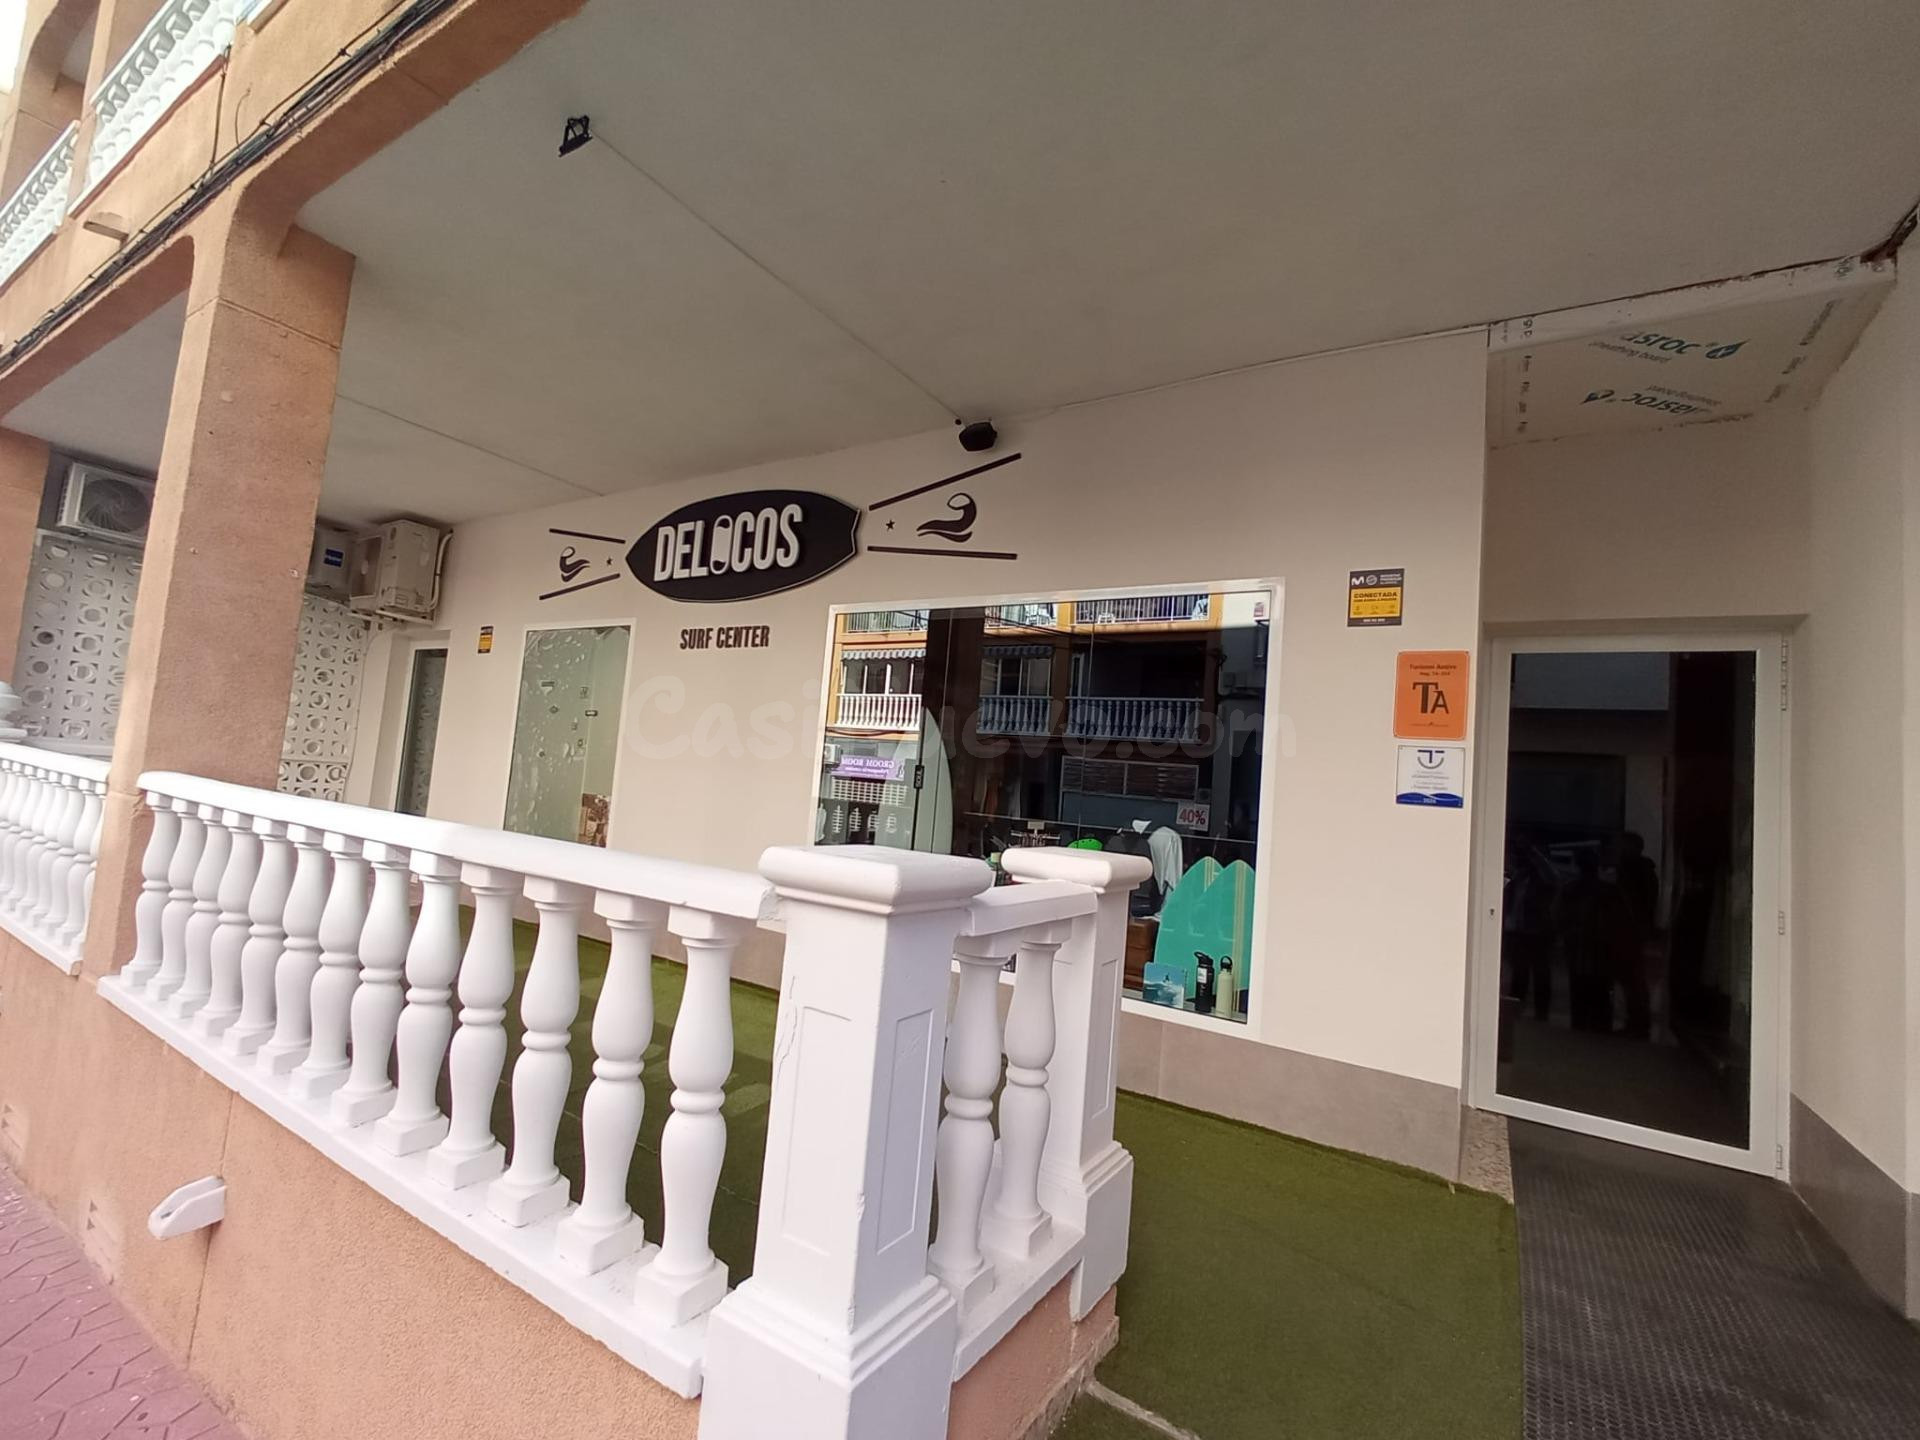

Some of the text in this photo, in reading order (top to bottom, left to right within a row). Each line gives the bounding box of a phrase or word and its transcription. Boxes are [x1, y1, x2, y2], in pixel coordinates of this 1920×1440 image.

[653, 503, 803, 582] DELOCOS
[1353, 591, 1398, 599] CONECTADA
[679, 625, 770, 650] SURF CENTER
[1178, 808, 1206, 825] 40%
